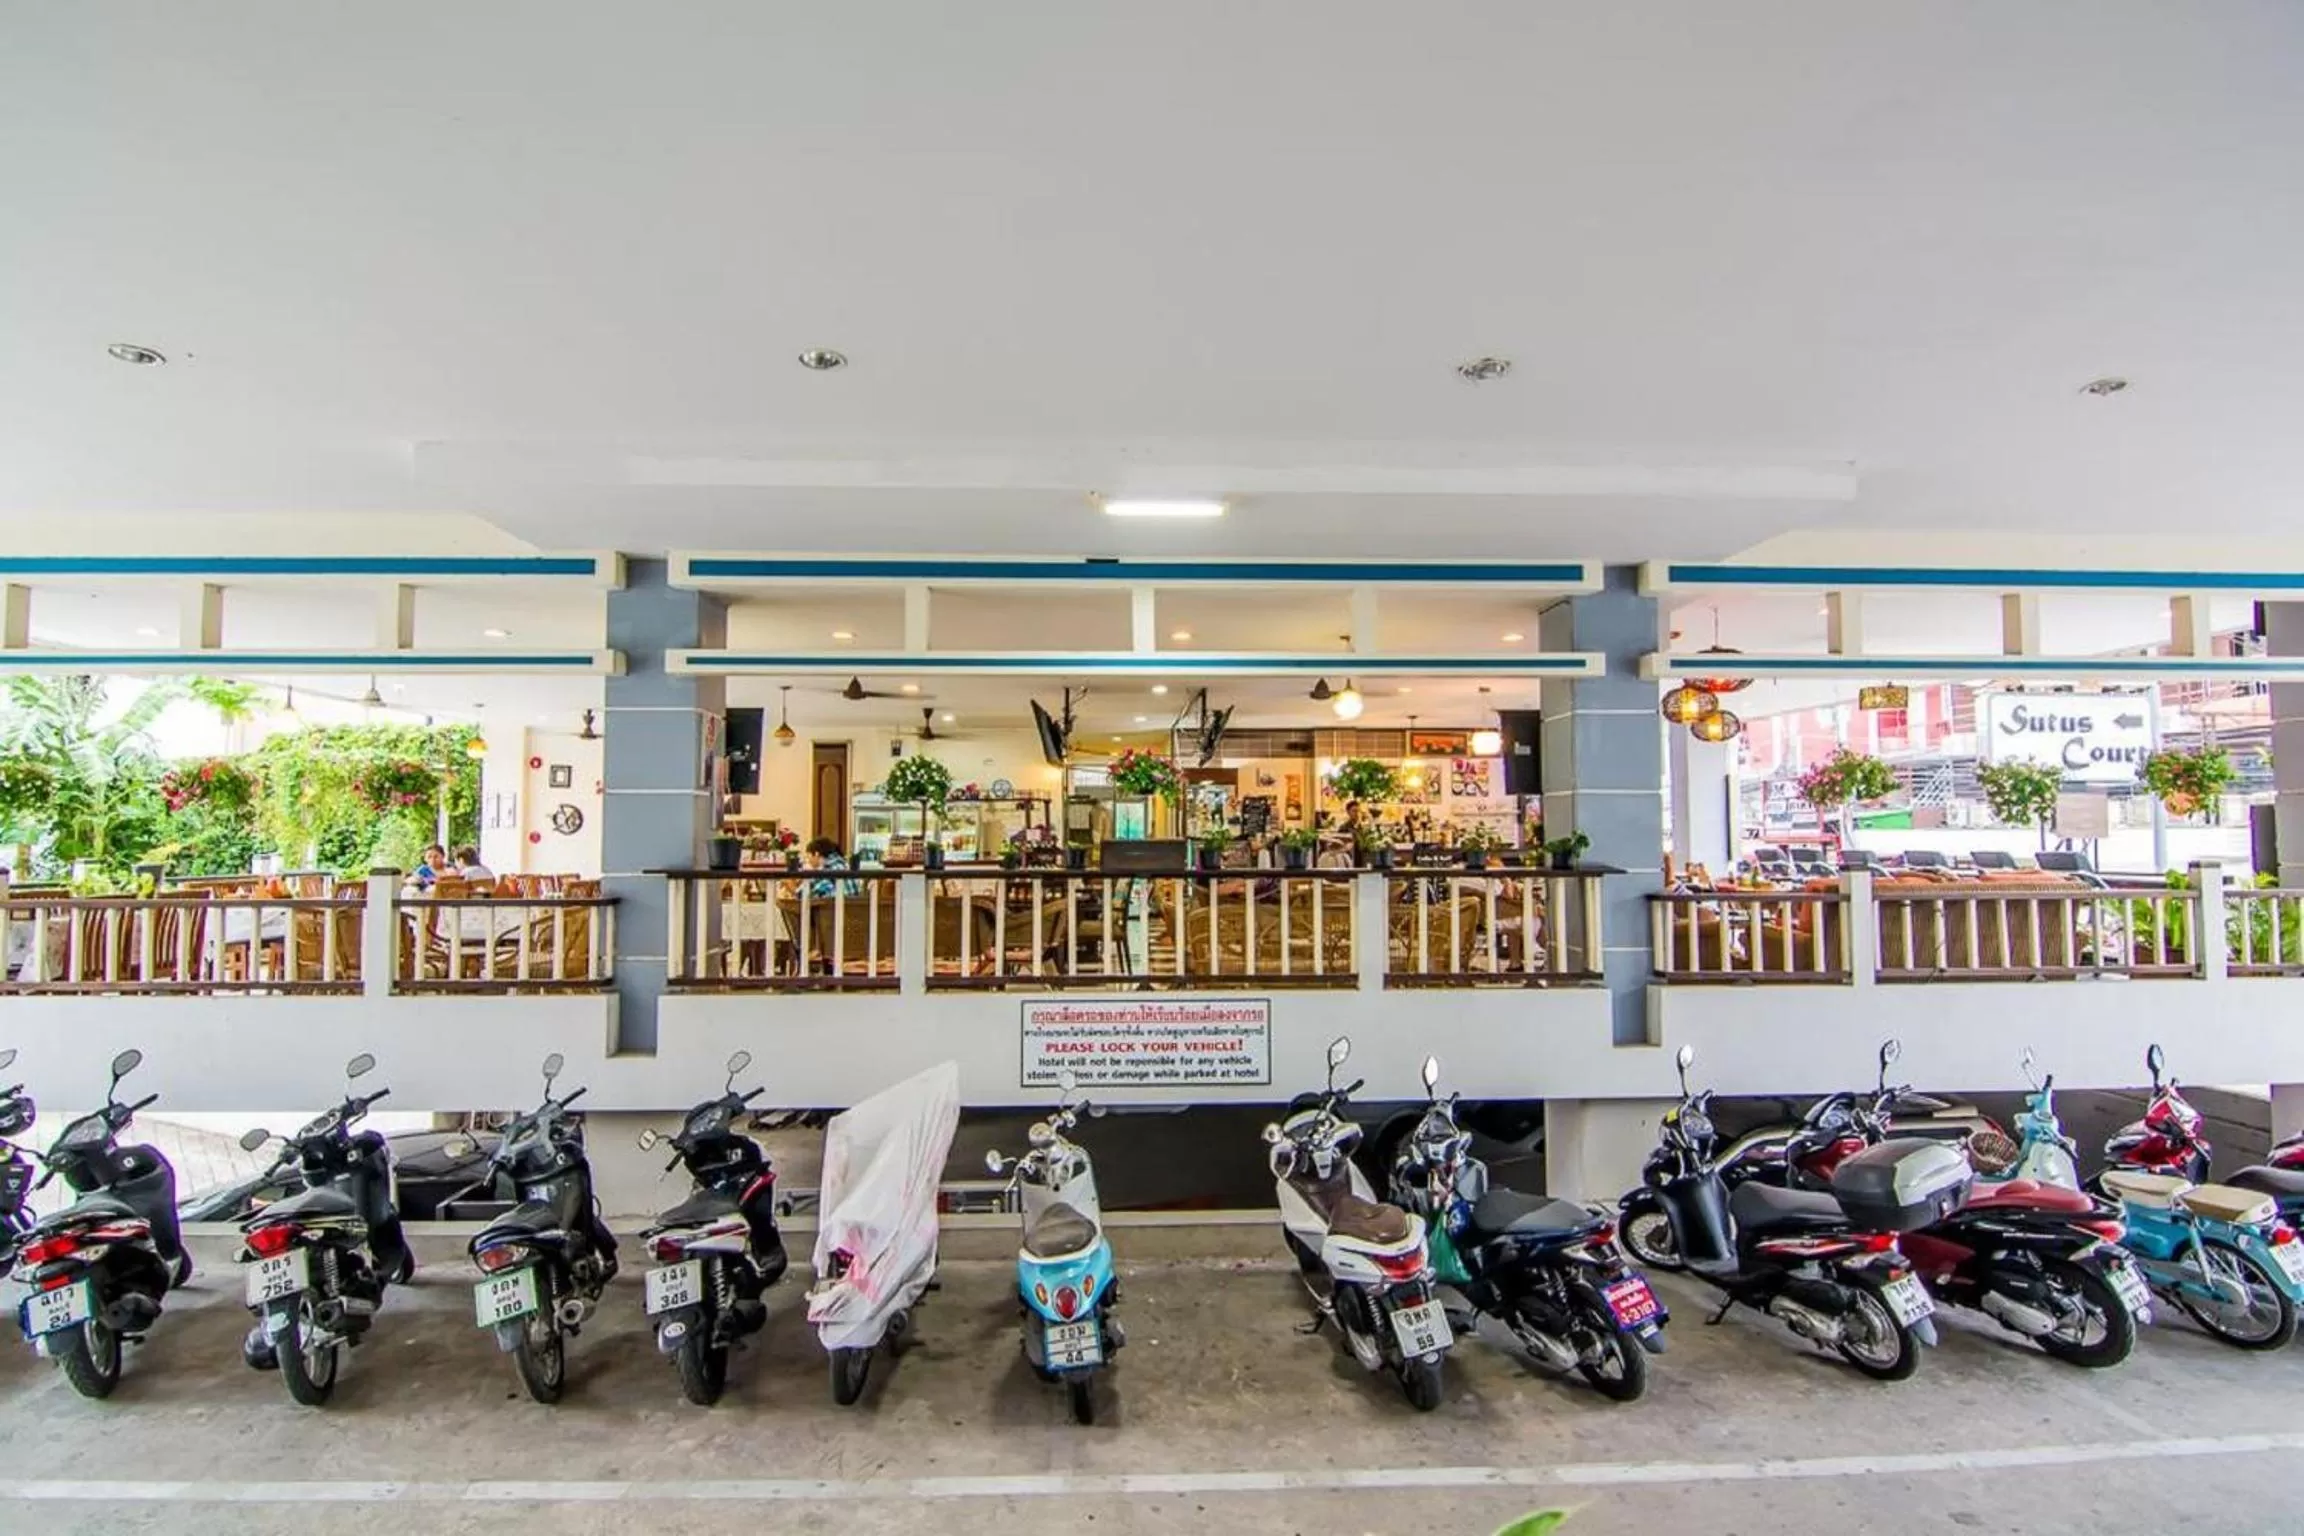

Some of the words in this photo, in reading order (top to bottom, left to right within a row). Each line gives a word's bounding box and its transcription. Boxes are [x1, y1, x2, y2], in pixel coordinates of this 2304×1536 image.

[2000, 705, 2094, 736] Sutus
[2062, 737, 2149, 770] Court
[1045, 1042, 1095, 1053] PLEASE
[1101, 1042, 1136, 1053] LOCK
[1142, 1042, 1178, 1052] YOUR
[1184, 1039, 1243, 1052] VEHICLE!
[1038, 1057, 1065, 1067] Hotel
[1068, 1057, 1087, 1066] will
[1090, 1058, 1107, 1067] not
[1110, 1057, 1122, 1066] be
[1180, 1055, 1193, 1065] for
[1198, 1057, 1215, 1067] any
[1218, 1055, 1252, 1065] vehicle
[1027, 1070, 1058, 1080] stolen
[1097, 1072, 1109, 1080] or
[1112, 1070, 1150, 1081] damage
[1154, 1068, 1181, 1078] while
[1184, 1068, 1218, 1080] parked
[1220, 1068, 1231, 1078] at
[1234, 1068, 1259, 1078] hotel
[262, 1279, 293, 1299] 752
